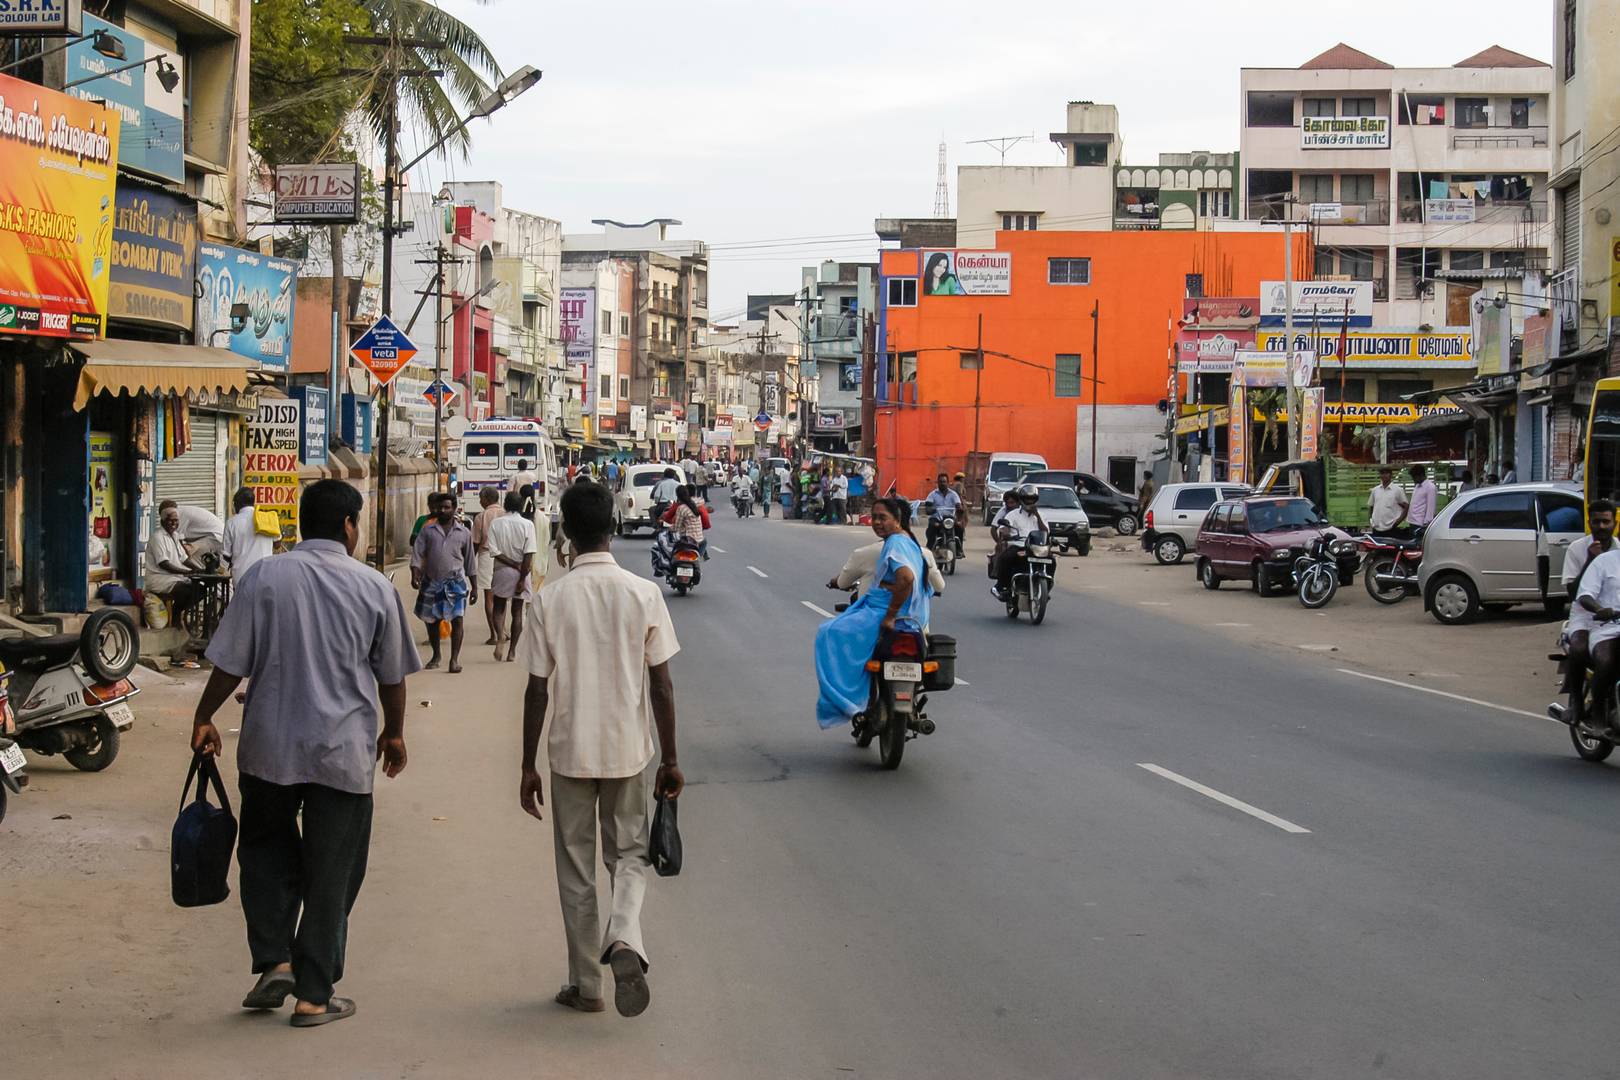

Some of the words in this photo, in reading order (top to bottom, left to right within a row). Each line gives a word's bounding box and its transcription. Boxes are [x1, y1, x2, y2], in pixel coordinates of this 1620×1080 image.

[42, 13, 60, 21] LAB
[277, 203, 312, 213] COMPUTER
[314, 203, 354, 213] EDUCATION
[27, 208, 78, 243] FASHIONS
[111, 240, 159, 273] BOMBAY
[160, 251, 183, 279] DYEING
[42, 313, 68, 330] TRIGGER
[1324, 406, 1411, 416] NARAYANA
[246, 428, 274, 449] FAX
[275, 429, 295, 438] HIGH
[275, 440, 298, 450] SPEED
[246, 454, 297, 472] XEROX
[245, 475, 294, 484] COLOUR
